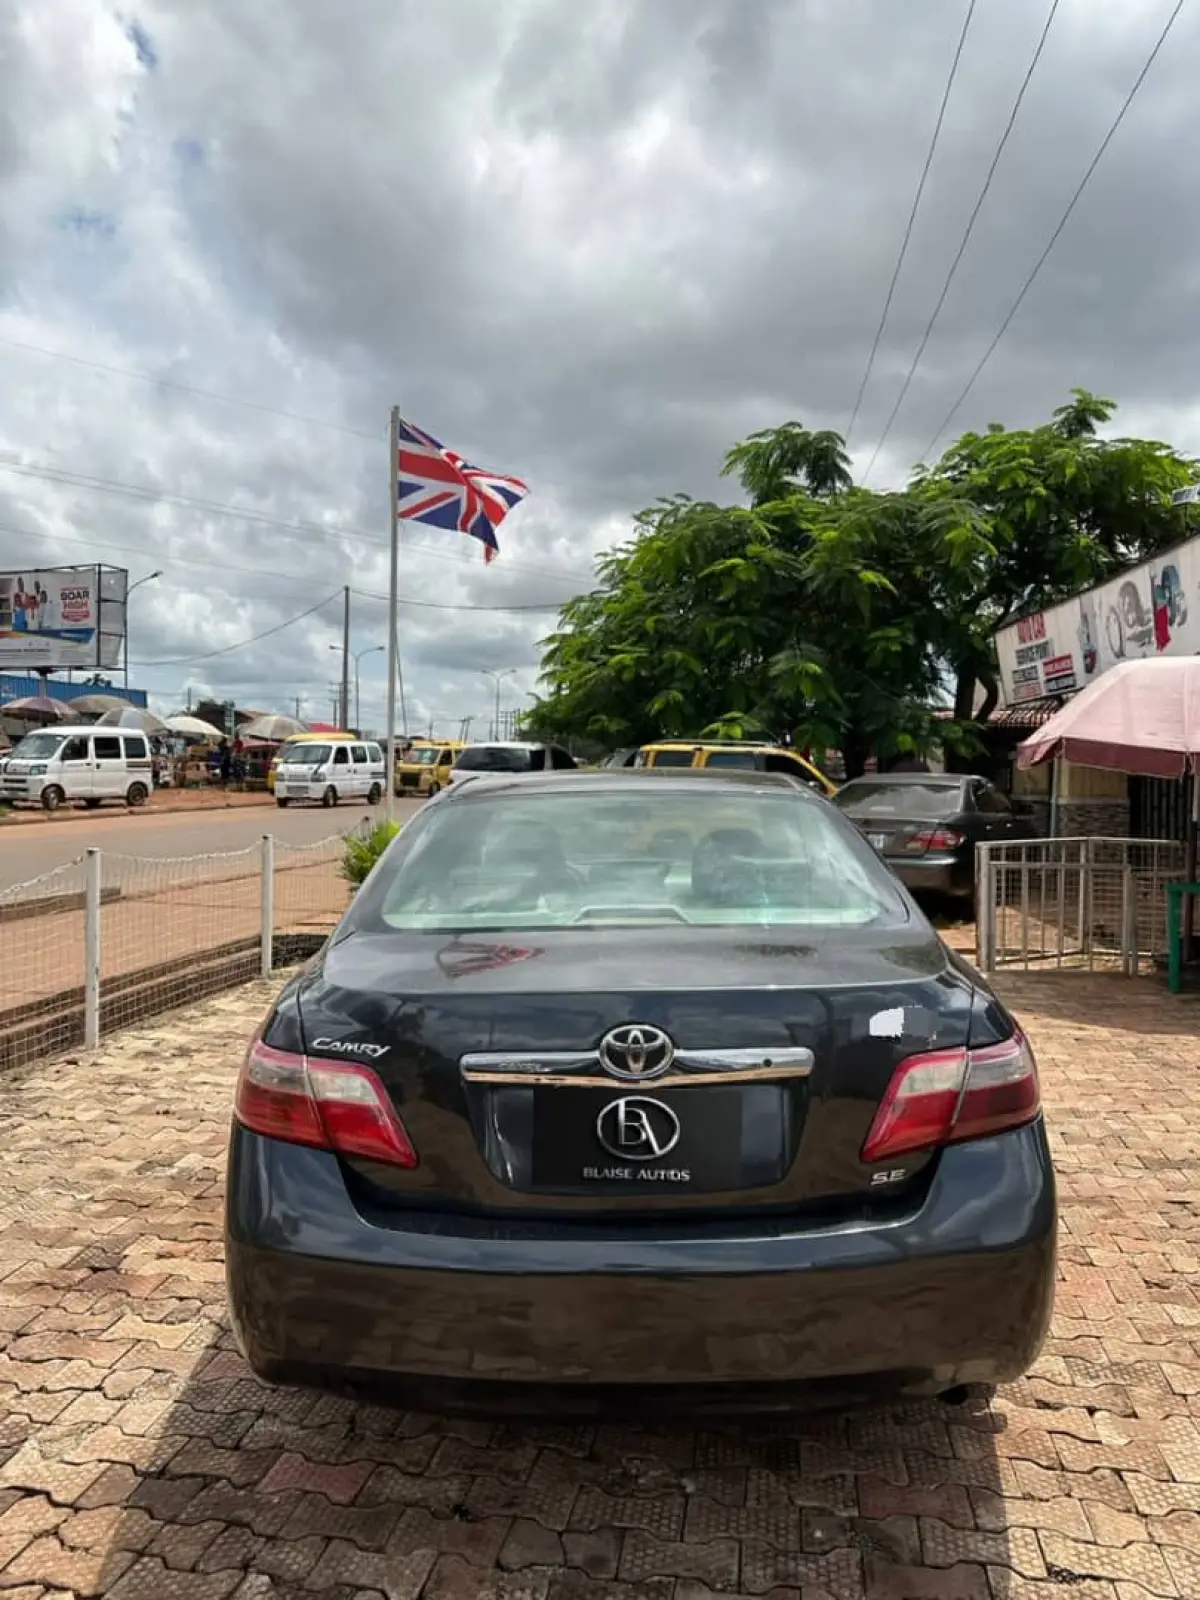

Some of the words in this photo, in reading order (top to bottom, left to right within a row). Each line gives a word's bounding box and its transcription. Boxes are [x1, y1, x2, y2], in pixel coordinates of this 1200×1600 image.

[60, 590, 90, 601] SOAR
[312, 1037, 391, 1057] Camry
[583, 1166, 632, 1179] BLAISE
[637, 1169, 691, 1181] AUTOS
[871, 1169, 906, 1186] SE
